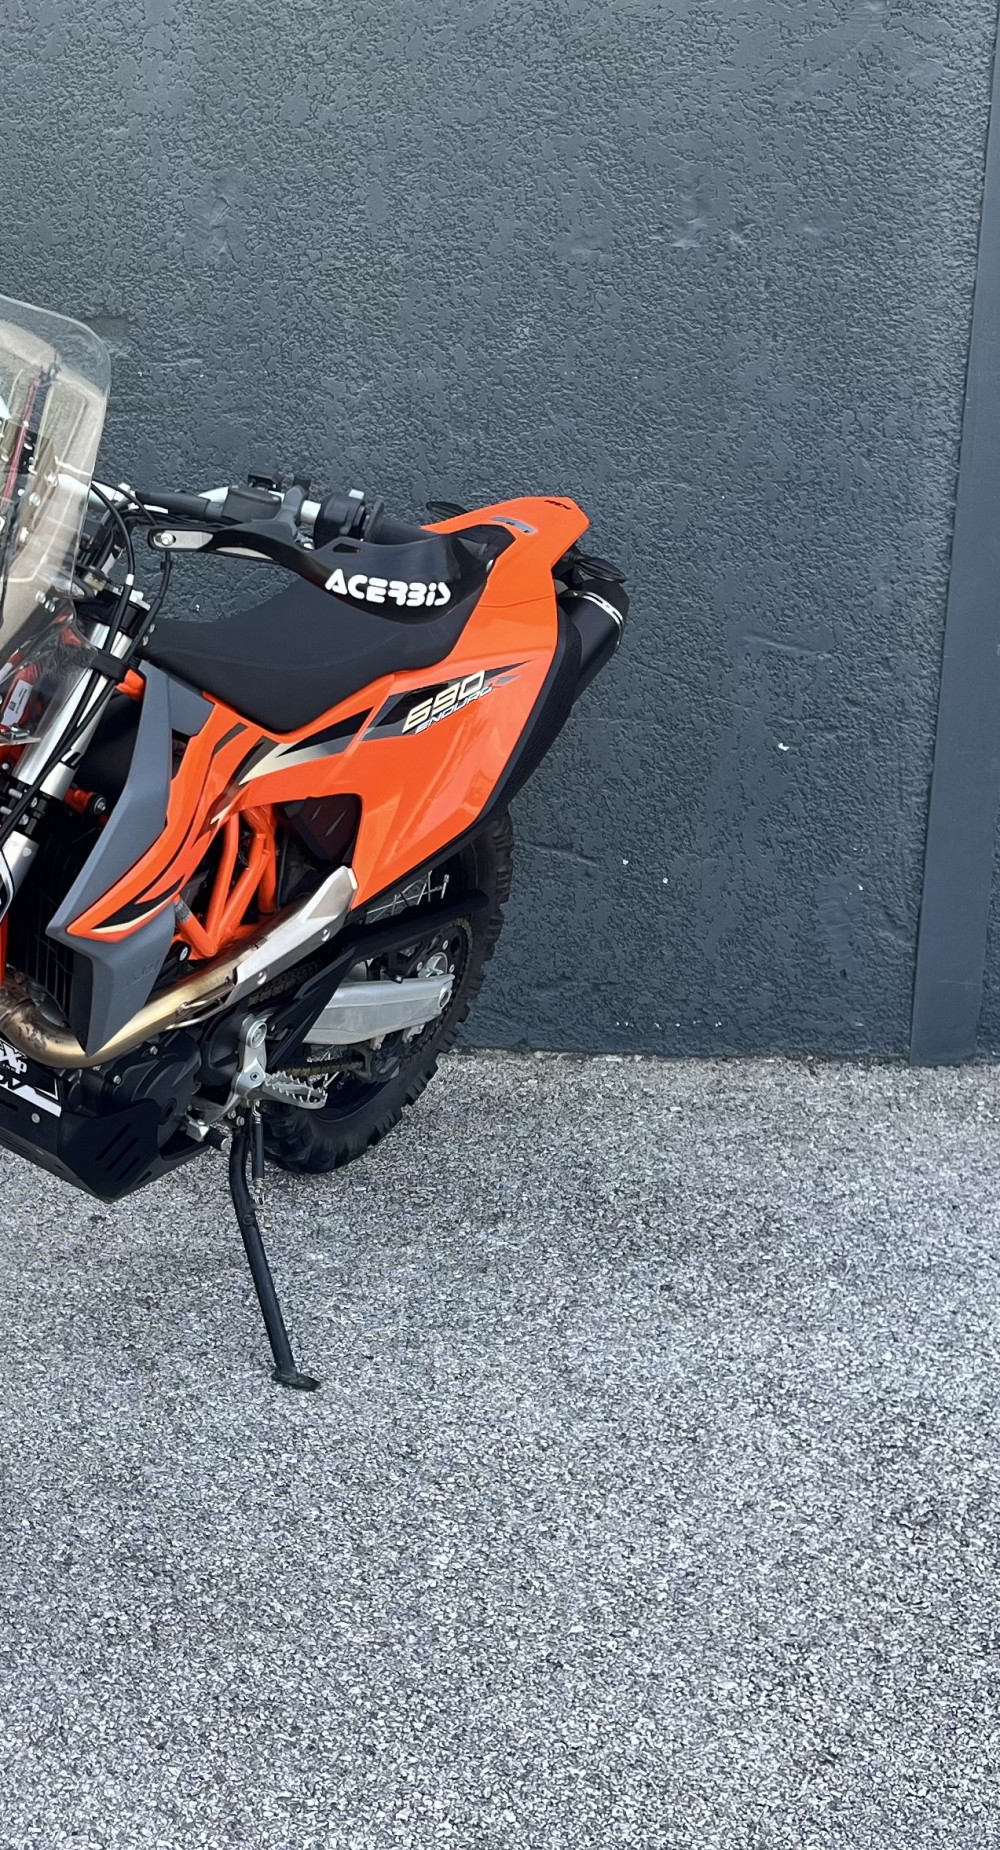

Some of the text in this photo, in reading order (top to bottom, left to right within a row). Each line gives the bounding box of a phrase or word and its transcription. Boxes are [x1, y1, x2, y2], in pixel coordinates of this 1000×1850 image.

[325, 568, 452, 607] ACERBIS
[402, 670, 485, 734] 690
[415, 686, 493, 735] ENDURO
